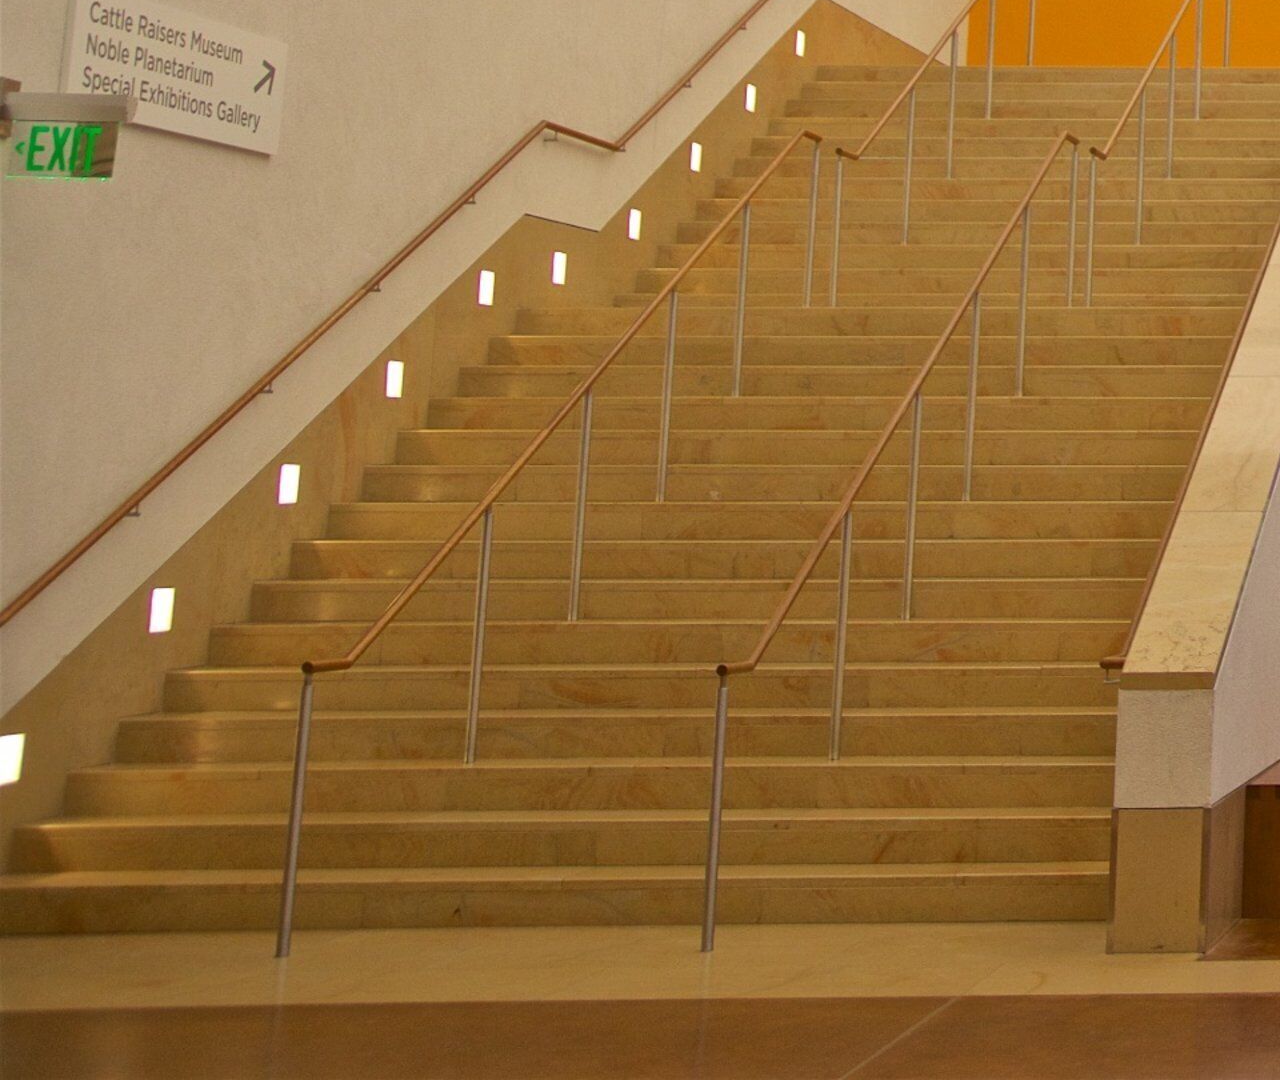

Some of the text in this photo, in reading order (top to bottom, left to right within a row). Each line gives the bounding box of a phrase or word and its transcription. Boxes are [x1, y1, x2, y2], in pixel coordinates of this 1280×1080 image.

[86, 33, 214, 87] Noble Planetarium
[89, 0, 244, 64] Cattle Raisers Museum
[82, 66, 261, 134] Special Exhibitions Gallery
[26, 124, 103, 173] EXIT
